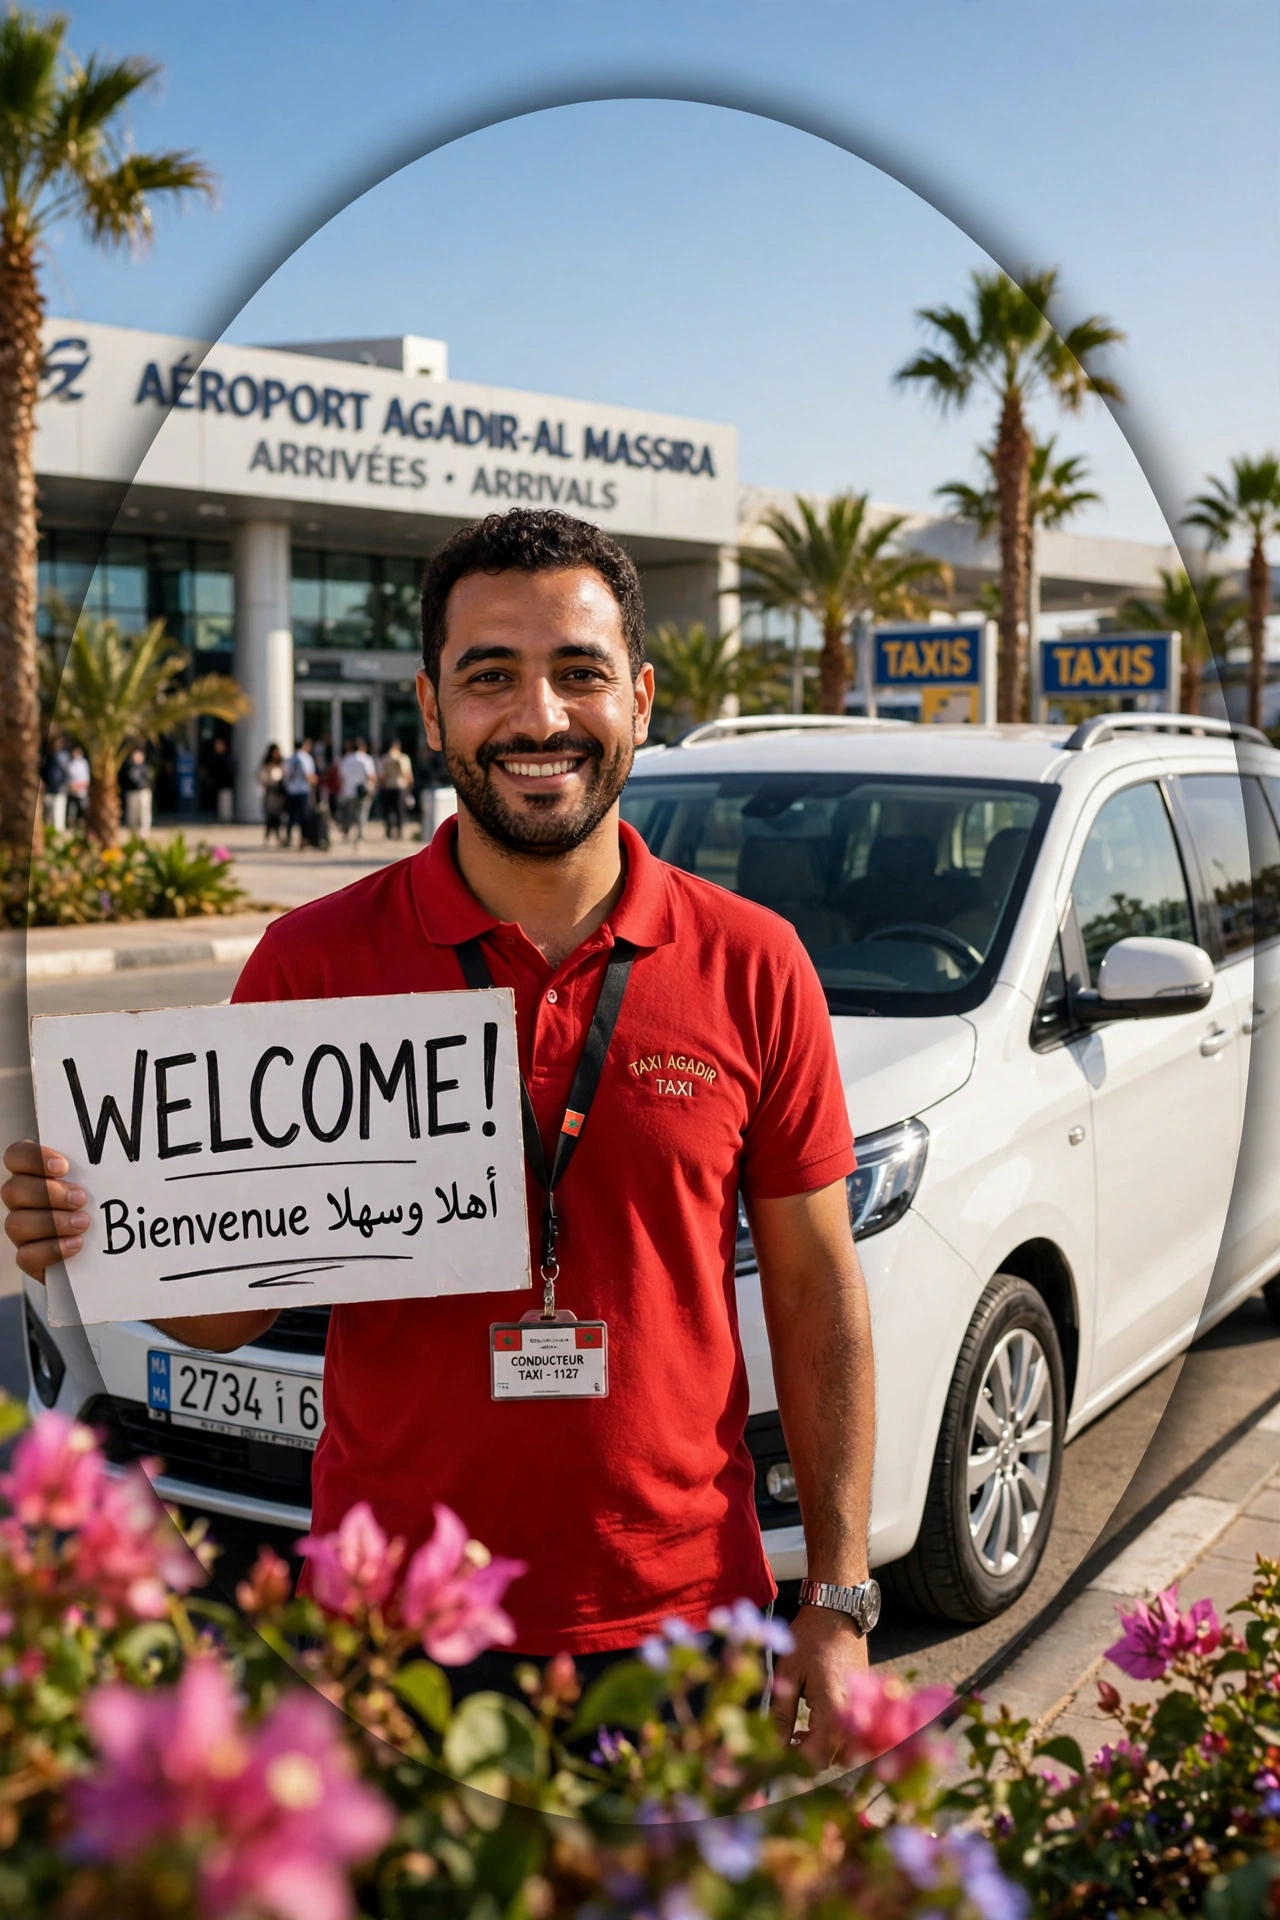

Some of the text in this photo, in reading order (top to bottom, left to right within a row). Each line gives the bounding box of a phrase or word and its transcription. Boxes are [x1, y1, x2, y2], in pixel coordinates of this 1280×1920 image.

[134, 354, 716, 478] AÉROPORT AGADIR-AL MASSIRA
[249, 439, 618, 511] ARRIVÉES ARRIVALS
[882, 638, 972, 677] TAXIS
[1053, 646, 1155, 687] TAXIS
[629, 1054, 717, 1085] TAXI AGADIR
[656, 1078, 693, 1097] TAXI
[62, 1021, 498, 1165] WELCOME!
[326, 1166, 498, 1238] أهلا وسهلا
[100, 1199, 310, 1255] Bienvenue
[151, 1356, 167, 1376] MA
[511, 1355, 584, 1366] CONDUCTEUR
[518, 1369, 543, 1381] TAXI
[554, 1368, 579, 1380] 1127
[152, 1385, 168, 1404] MA
[179, 1365, 262, 1421] 2734
